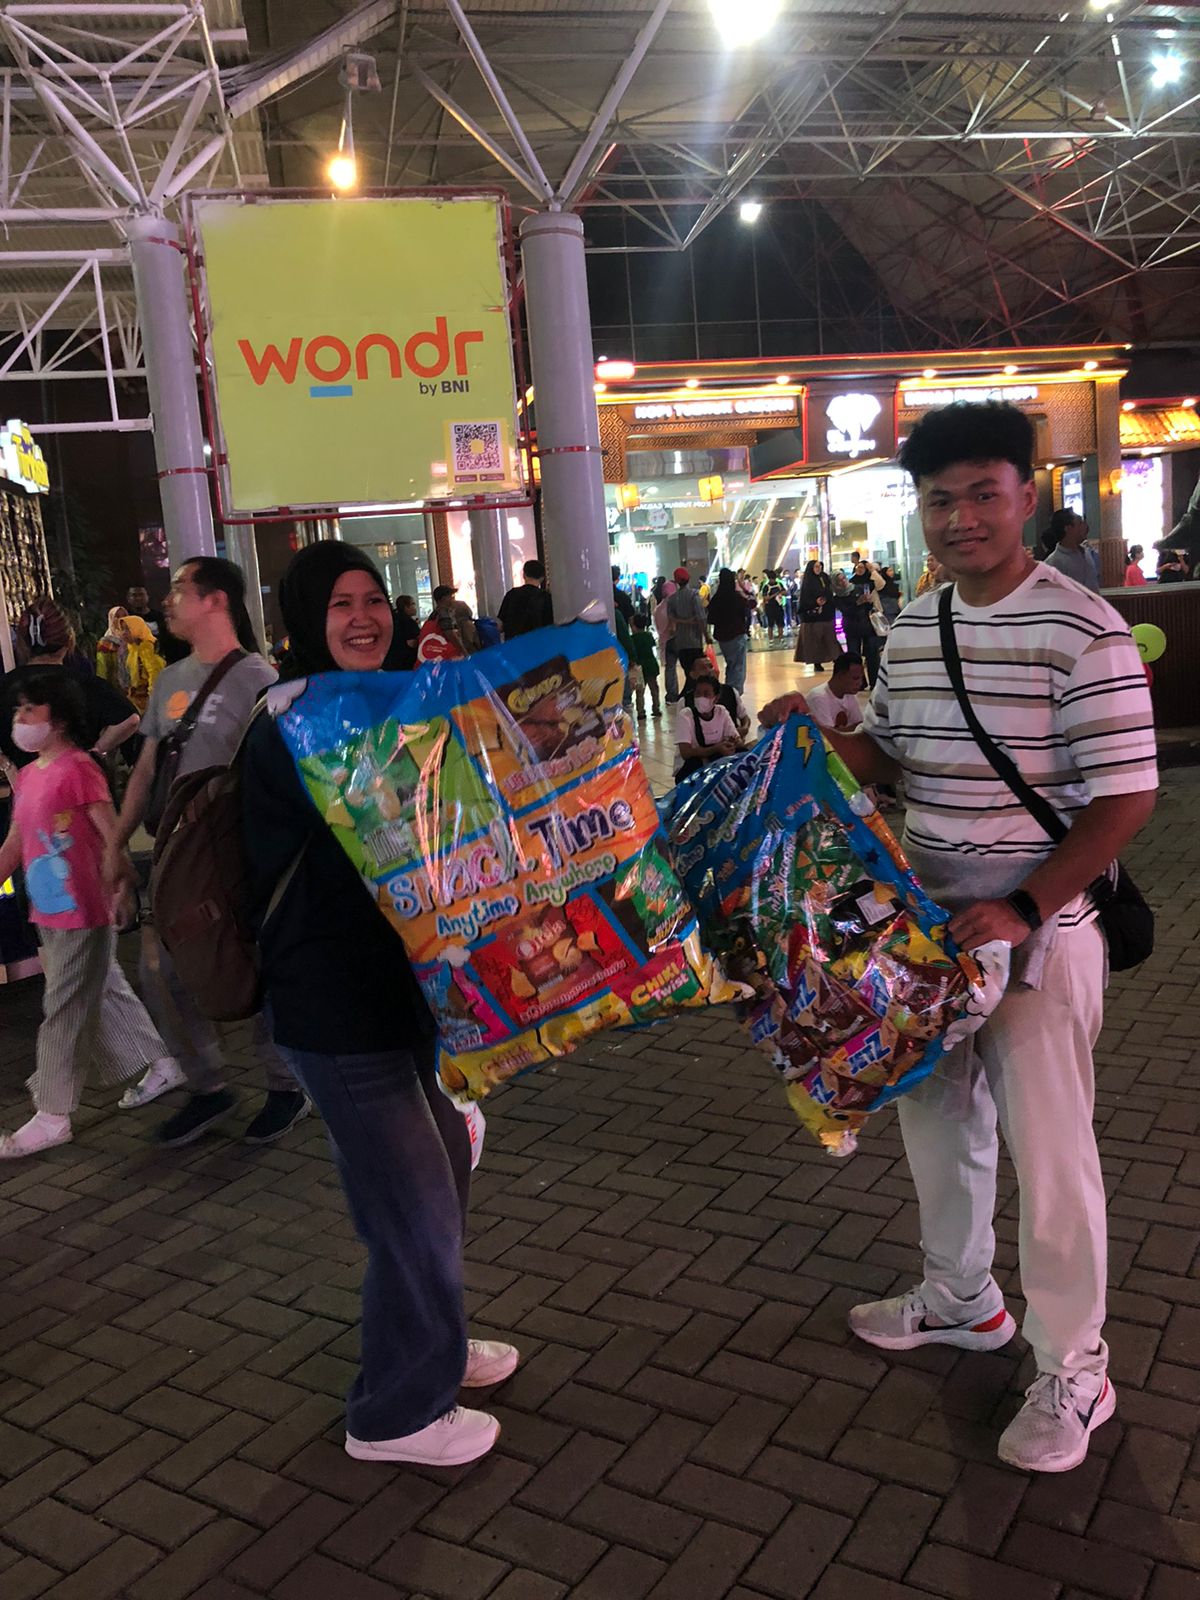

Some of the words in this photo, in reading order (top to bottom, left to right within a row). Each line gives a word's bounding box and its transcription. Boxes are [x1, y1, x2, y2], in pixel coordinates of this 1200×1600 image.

[237, 316, 484, 386] wondr
[419, 382, 437, 396] by
[441, 380, 470, 394] BNI
[435, 896, 520, 940] Anytime
[523, 852, 616, 907] Anywhere
[630, 961, 681, 1006] CHIKI
[650, 972, 690, 1002] Twist
[848, 1029, 892, 1077] JETZ
